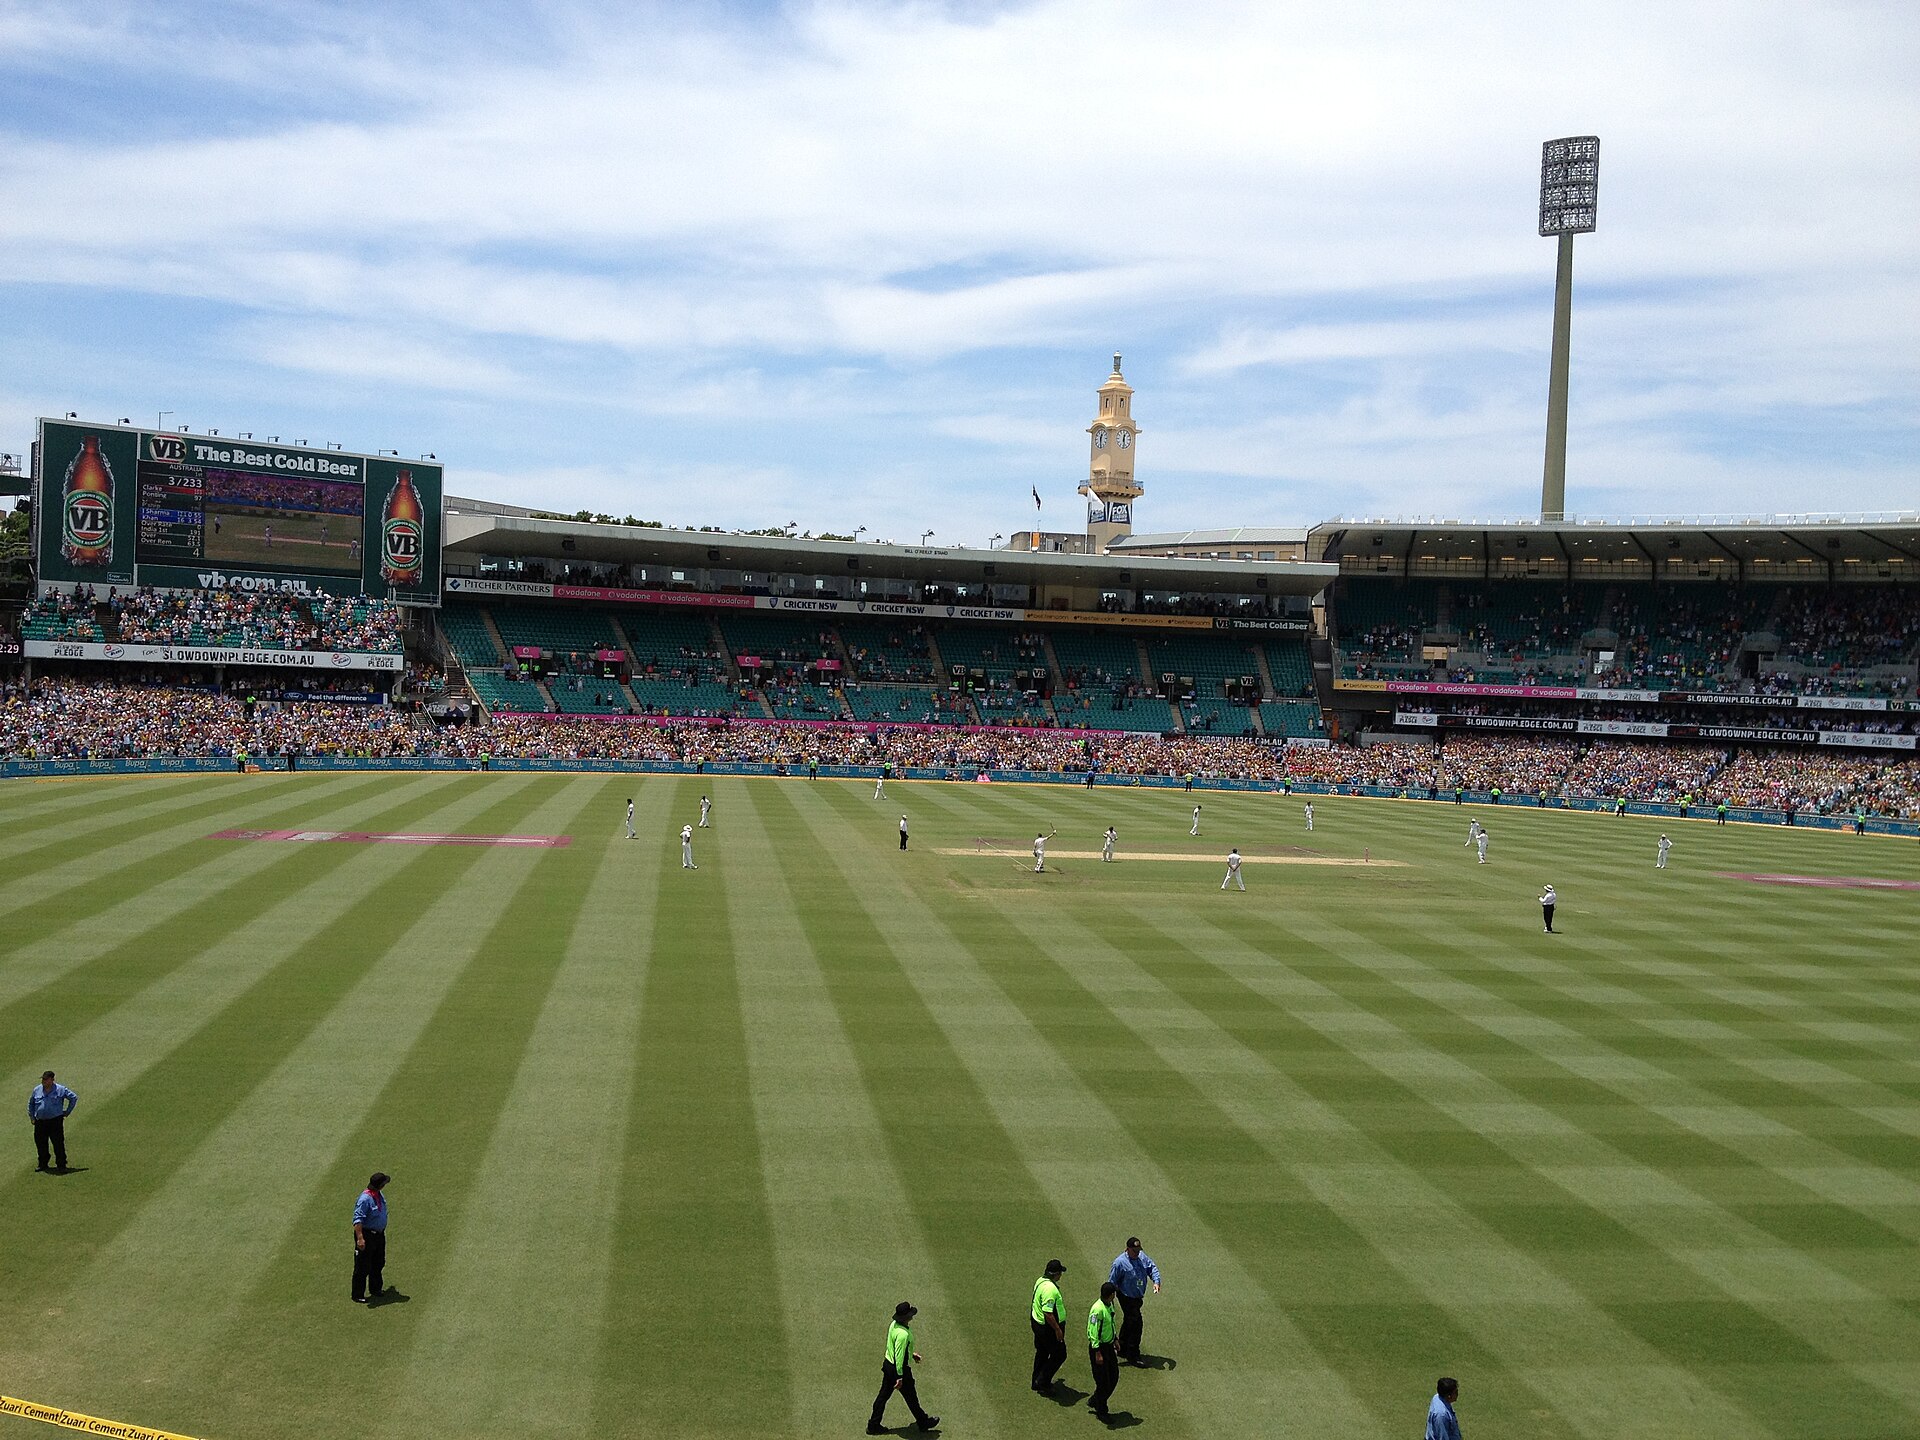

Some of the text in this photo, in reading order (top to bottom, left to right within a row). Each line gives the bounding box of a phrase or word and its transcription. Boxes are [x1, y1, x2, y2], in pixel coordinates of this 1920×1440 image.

[152, 439, 186, 459] VB
[194, 445, 358, 476] The Best Cold Beer
[168, 477, 202, 488] 3/233
[1113, 505, 1127, 515] FOX
[70, 507, 109, 531] VB
[388, 534, 419, 555] VB
[193, 548, 200, 557] 4
[198, 571, 307, 592] vbcomau
[464, 580, 503, 590] PITCHER
[505, 582, 550, 593] PARTNERS
[784, 600, 837, 610] CRICKET NSW
[872, 605, 925, 614] CRICKET NSW
[960, 609, 1014, 618] CRICKET NSW
[1218, 619, 1230, 628] VB
[163, 651, 314, 665] SLOWDOWNPLEDGE.COM.AU
[953, 666, 965, 676] VB
[1033, 669, 1045, 678] VB
[1163, 674, 1175, 683] VB
[1241, 677, 1254, 686] VB
[1687, 695, 1792, 705] SLOWDOWNPLEDGE.COM.AU
[1466, 718, 1574, 730] SLOWDOWNPLEDGE.COM.AU
[1699, 728, 1814, 741] SLOWDOWNPLEDGE.COM.AU
[18, 762, 38, 770] Bupa
[54, 761, 74, 769] Bupa
[125, 760, 144, 768] Bupa
[161, 760, 180, 768] Bupa
[0, 1400, 23, 1413] Zuari
[24, 1406, 59, 1421] Cement
[60, 1414, 86, 1428] Zuari
[88, 1421, 127, 1436] Cement
